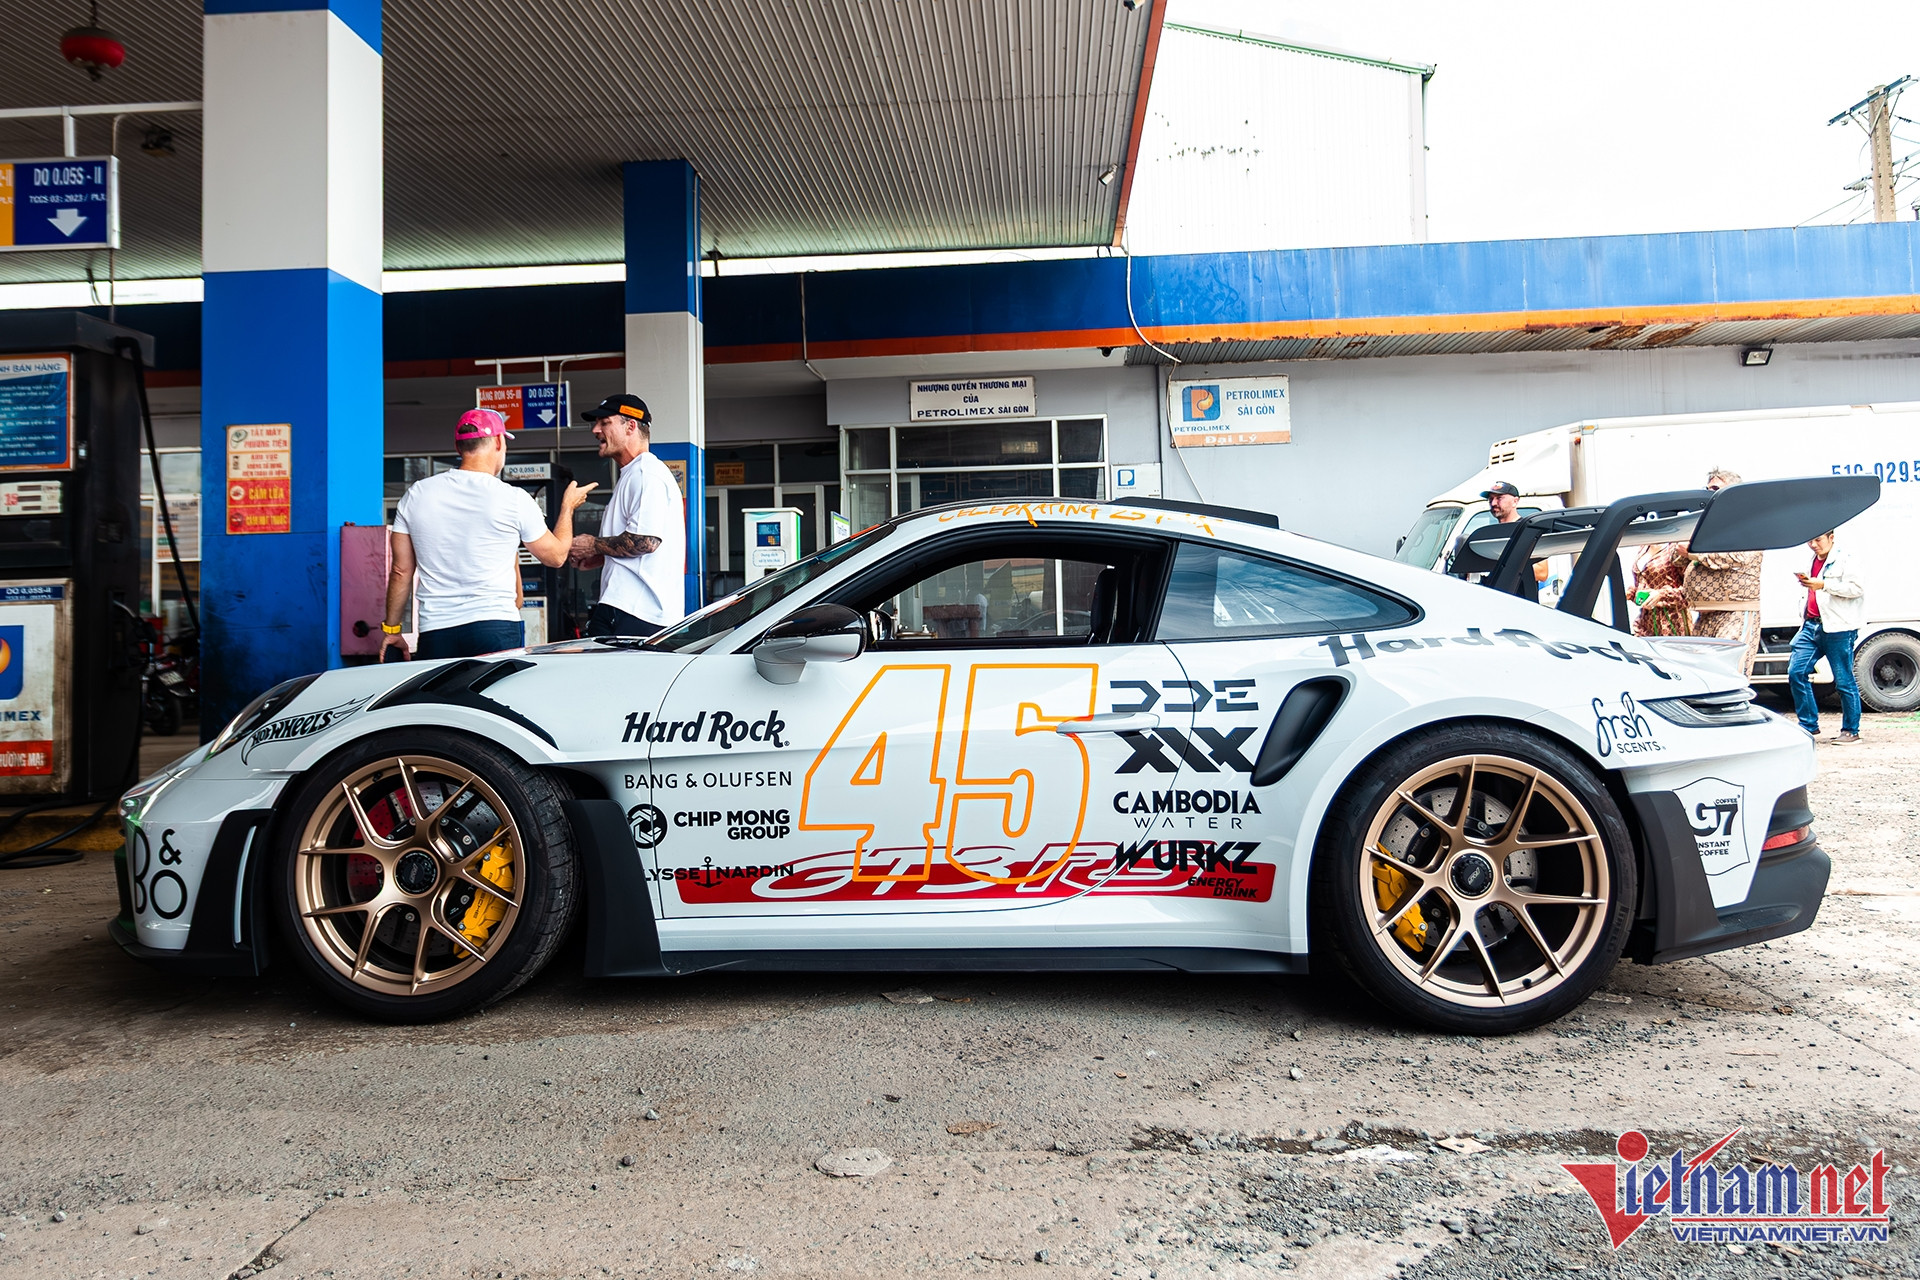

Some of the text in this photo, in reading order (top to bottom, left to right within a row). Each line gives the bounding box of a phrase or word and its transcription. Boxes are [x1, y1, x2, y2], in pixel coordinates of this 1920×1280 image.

[917, 383, 950, 394] NHƯỢNG
[979, 380, 1010, 390] THƯƠNG
[1011, 380, 1027, 390] MẠI
[1226, 388, 1286, 400] PETROLIMEX
[963, 393, 980, 404] CỦA
[917, 403, 1030, 418] PETROLIMEX SÀI GÒN
[1237, 402, 1276, 416] SÀI GÒN
[1174, 424, 1231, 433] PETROLIMEX
[1239, 433, 1258, 445] Lý
[1318, 628, 1673, 680] Hard Rock
[621, 711, 786, 750] Hard Rock
[1617, 741, 1661, 754] SCENTS
[624, 771, 792, 789] BANG & OLUFSEN
[799, 663, 1100, 885] 45
[1113, 789, 1262, 815] CAMBODIA
[673, 809, 791, 828] CHIP MONG
[1693, 802, 1739, 837] G7
[727, 825, 791, 841] GROUP
[1115, 839, 1262, 875] WURKZ
[716, 864, 795, 881] NARDIN
[1187, 876, 1245, 889] ENERGY
[1213, 887, 1259, 899] DRINK
